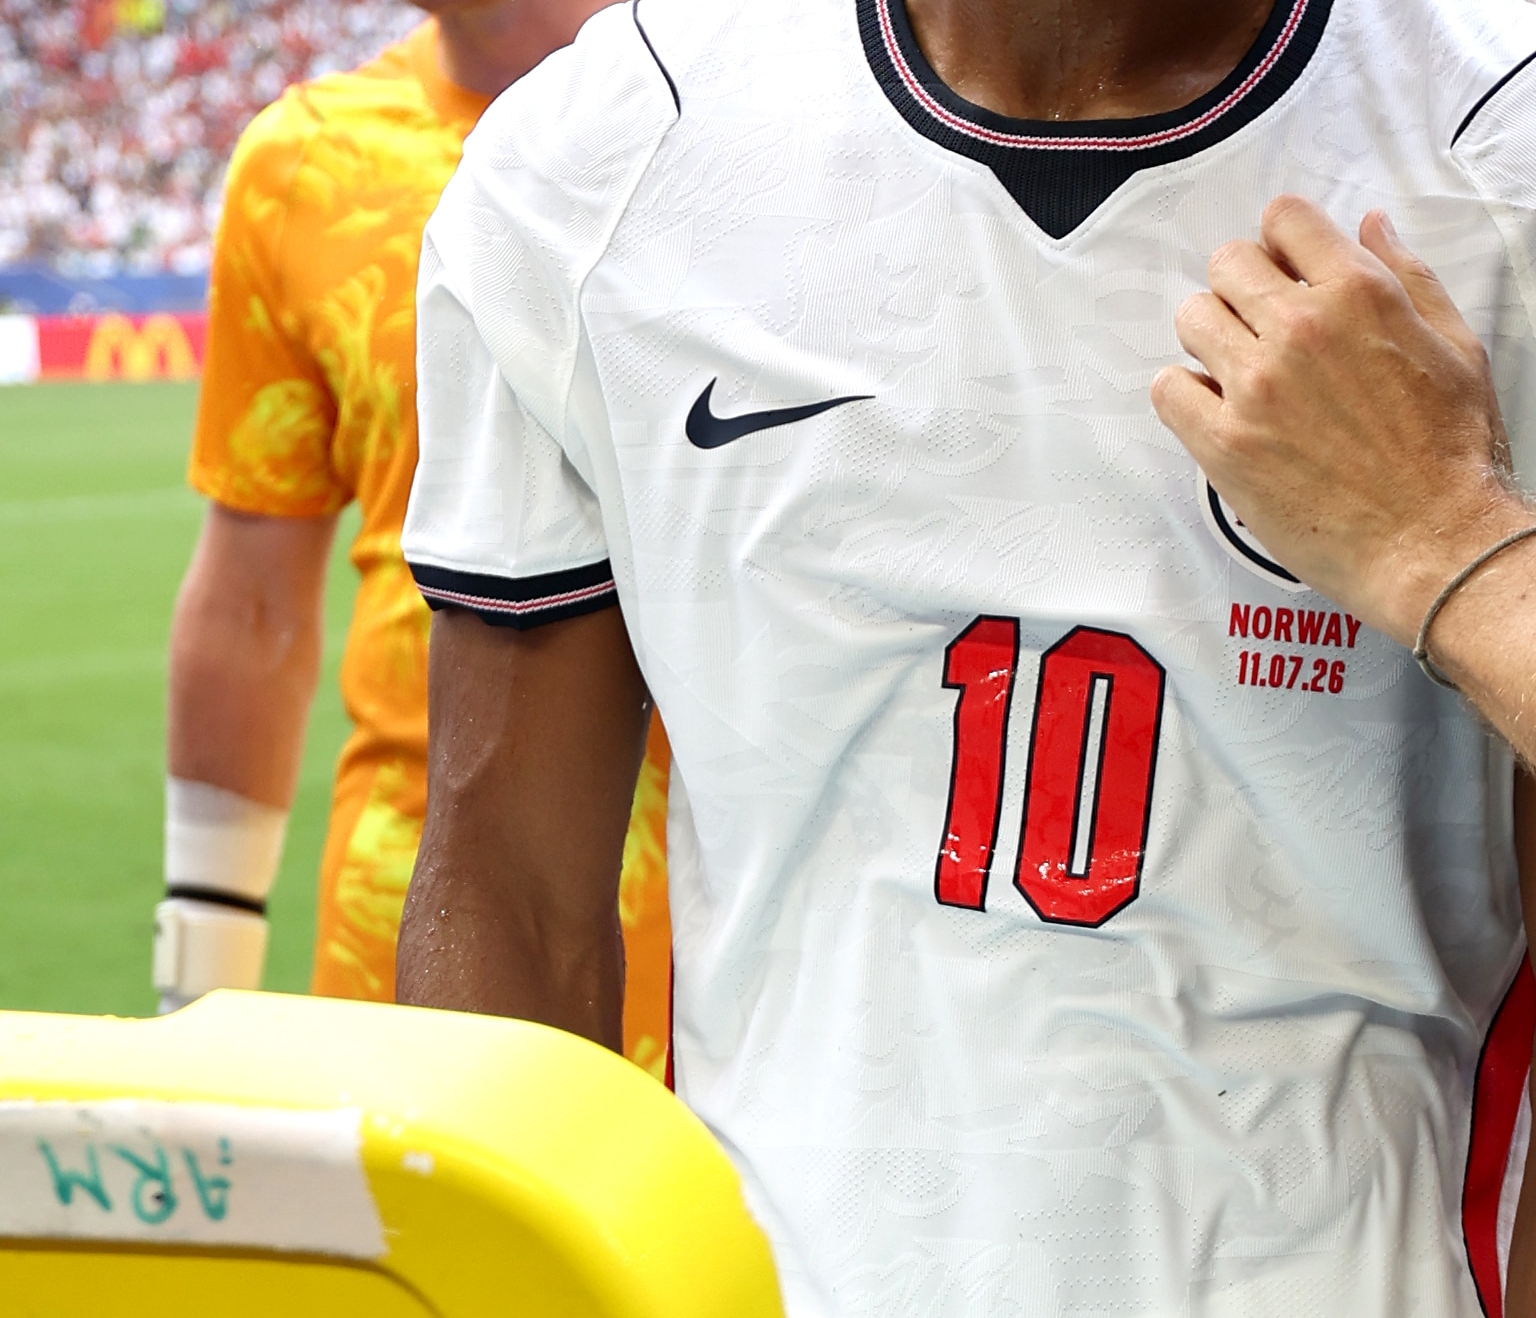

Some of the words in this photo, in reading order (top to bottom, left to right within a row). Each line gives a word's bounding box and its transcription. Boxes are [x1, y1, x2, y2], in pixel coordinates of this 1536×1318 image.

[1228, 602, 1362, 649] NORWAY
[1238, 650, 1346, 694] 11.07.26
[934, 613, 1167, 929] 10
[37, 1136, 233, 1224] ARM
